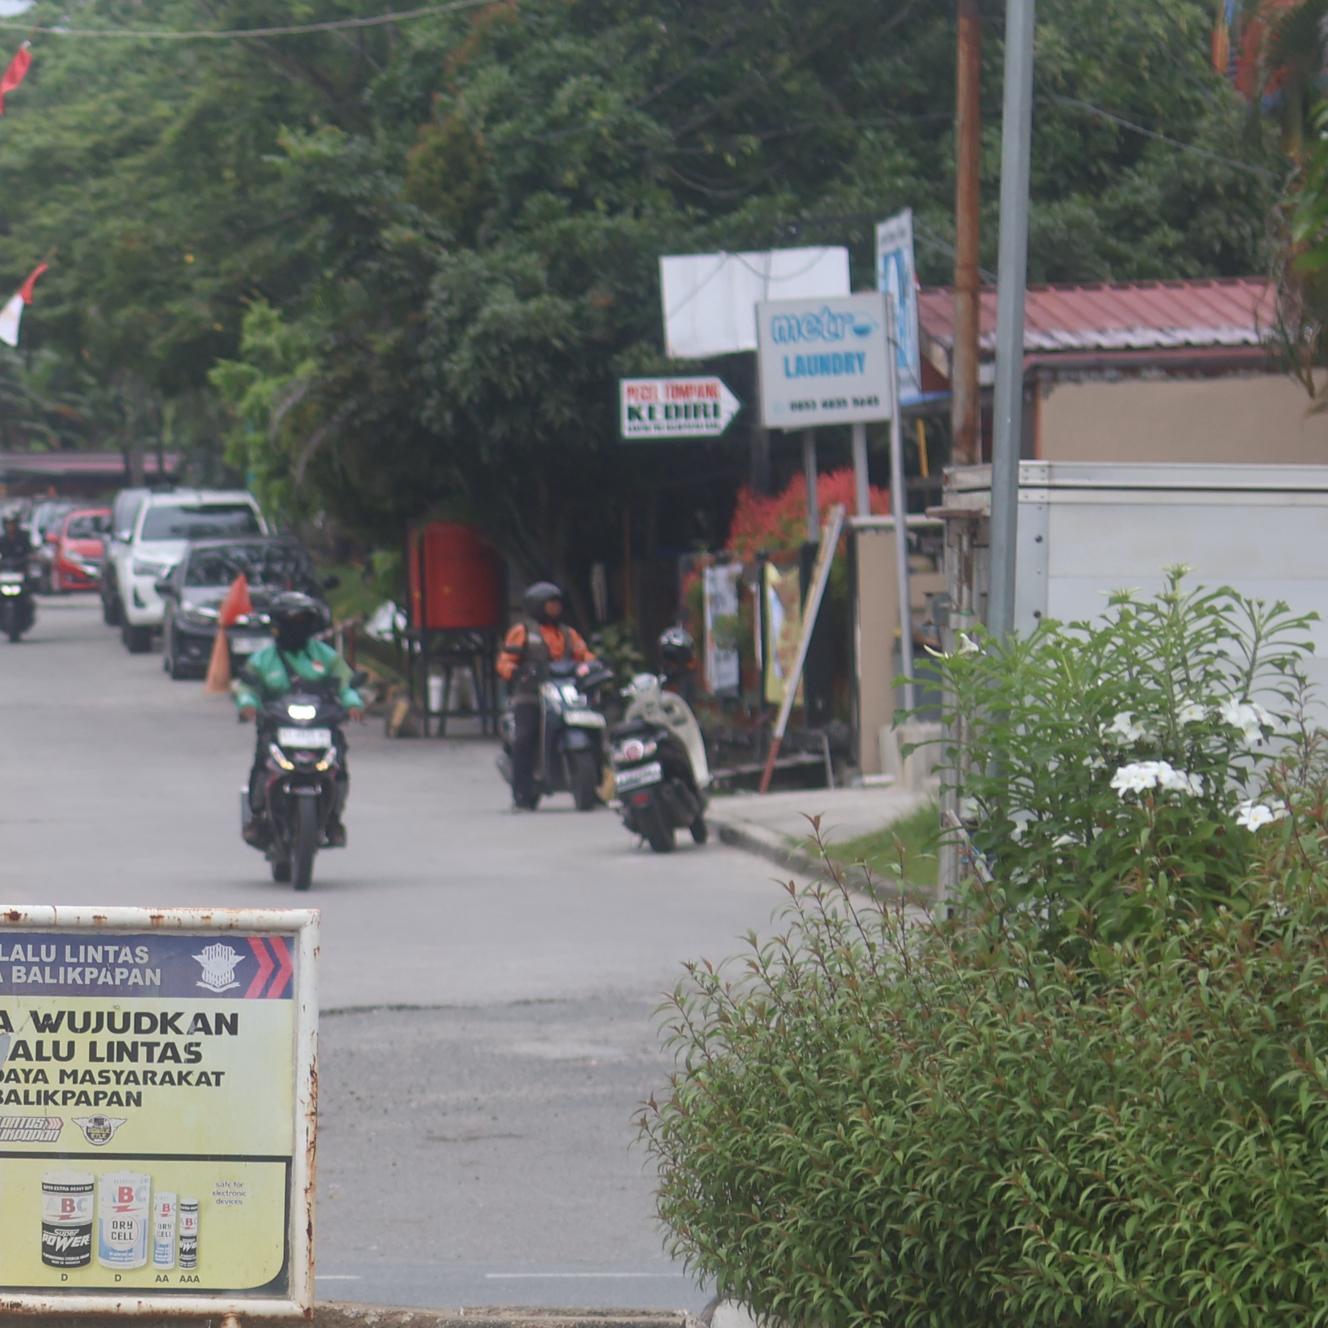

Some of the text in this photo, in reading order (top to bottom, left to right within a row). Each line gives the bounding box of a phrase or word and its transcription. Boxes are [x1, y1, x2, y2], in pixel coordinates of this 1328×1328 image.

[784, 352, 866, 379] LAUNDRY
[65, 945, 150, 964] LINTAS
[12, 965, 161, 986] BALIKPAPAN
[30, 1010, 239, 1036] WUJUDKAN
[4, 1039, 76, 1062] ALU
[88, 1040, 203, 1064] LINTAS
[59, 1068, 226, 1087] MASYARAKAT
[112, 1221, 134, 1230] DRY
[43, 1234, 91, 1252] POWER
[111, 1231, 134, 1241] CELL
[61, 1273, 69, 1281] D
[114, 1274, 122, 1282] D
[155, 1274, 169, 1283] AA
[179, 1275, 200, 1283] AAA
